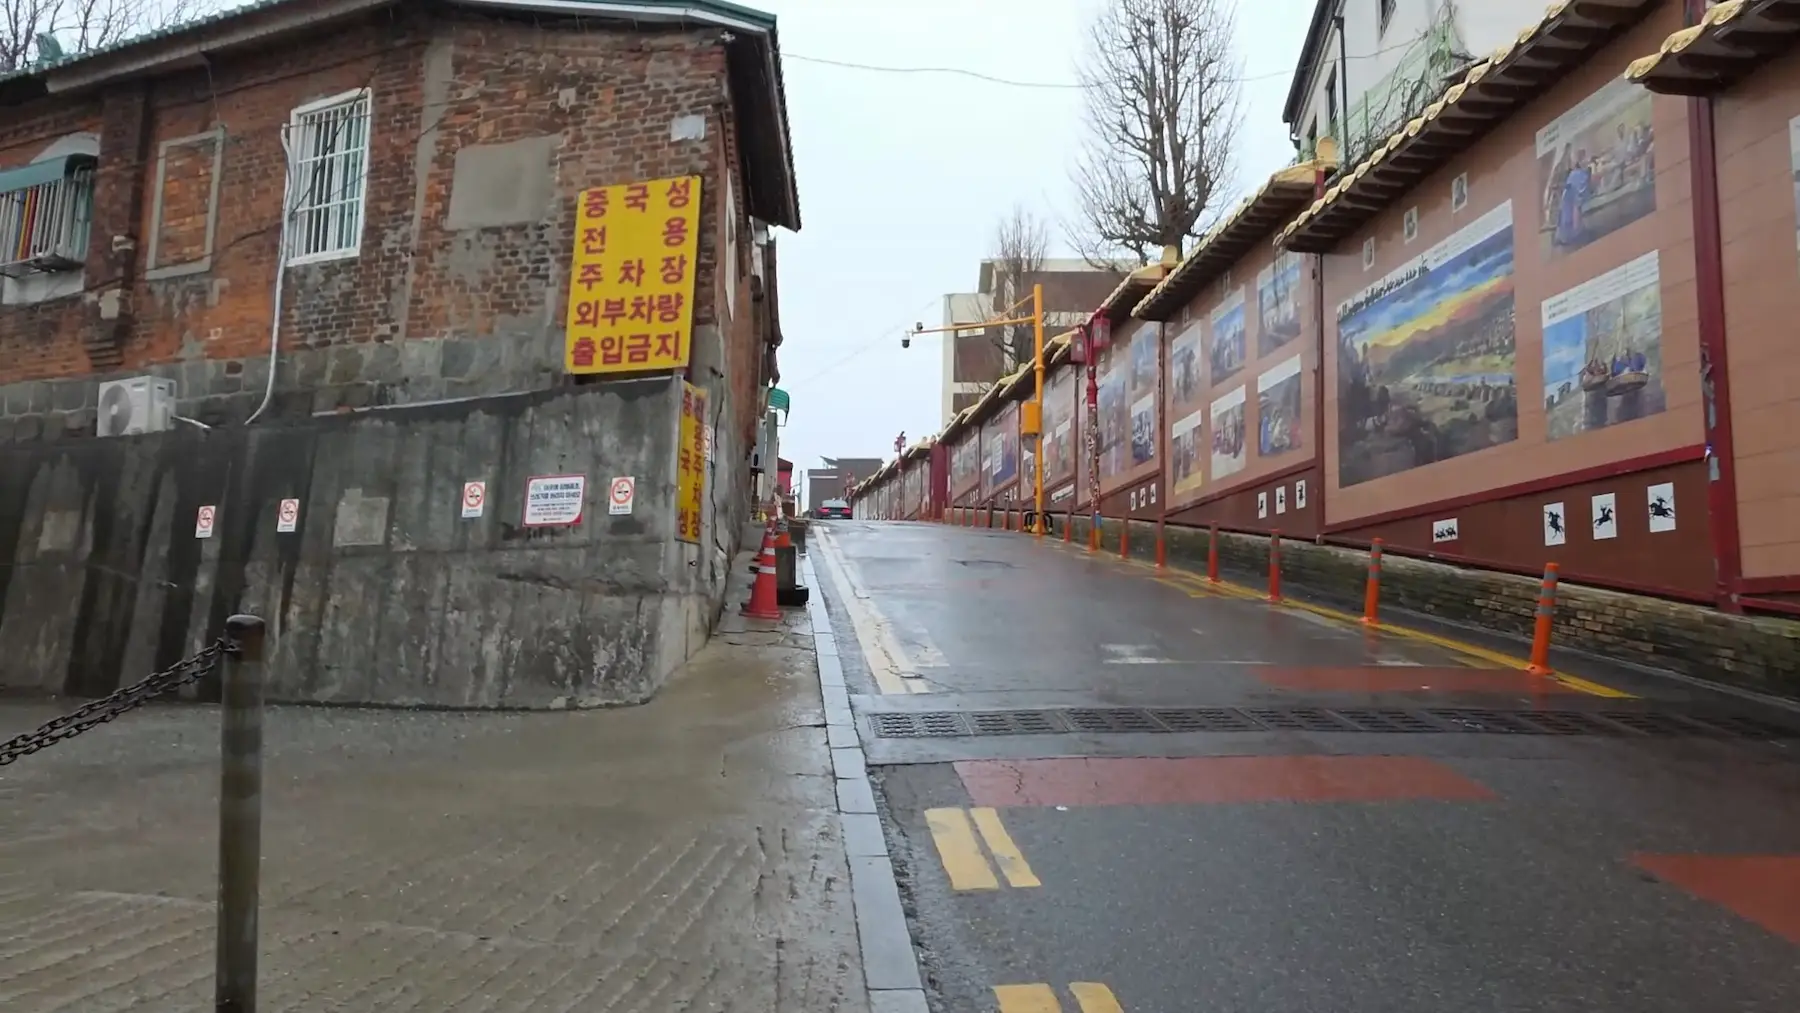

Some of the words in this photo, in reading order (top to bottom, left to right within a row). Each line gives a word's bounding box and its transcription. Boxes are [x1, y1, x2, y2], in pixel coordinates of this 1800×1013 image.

[584, 179, 690, 218] 중국성
[582, 216, 688, 255] 전용
[577, 254, 687, 291] 주차장
[574, 292, 684, 328] 외부차량
[571, 330, 682, 366] 출입금지
